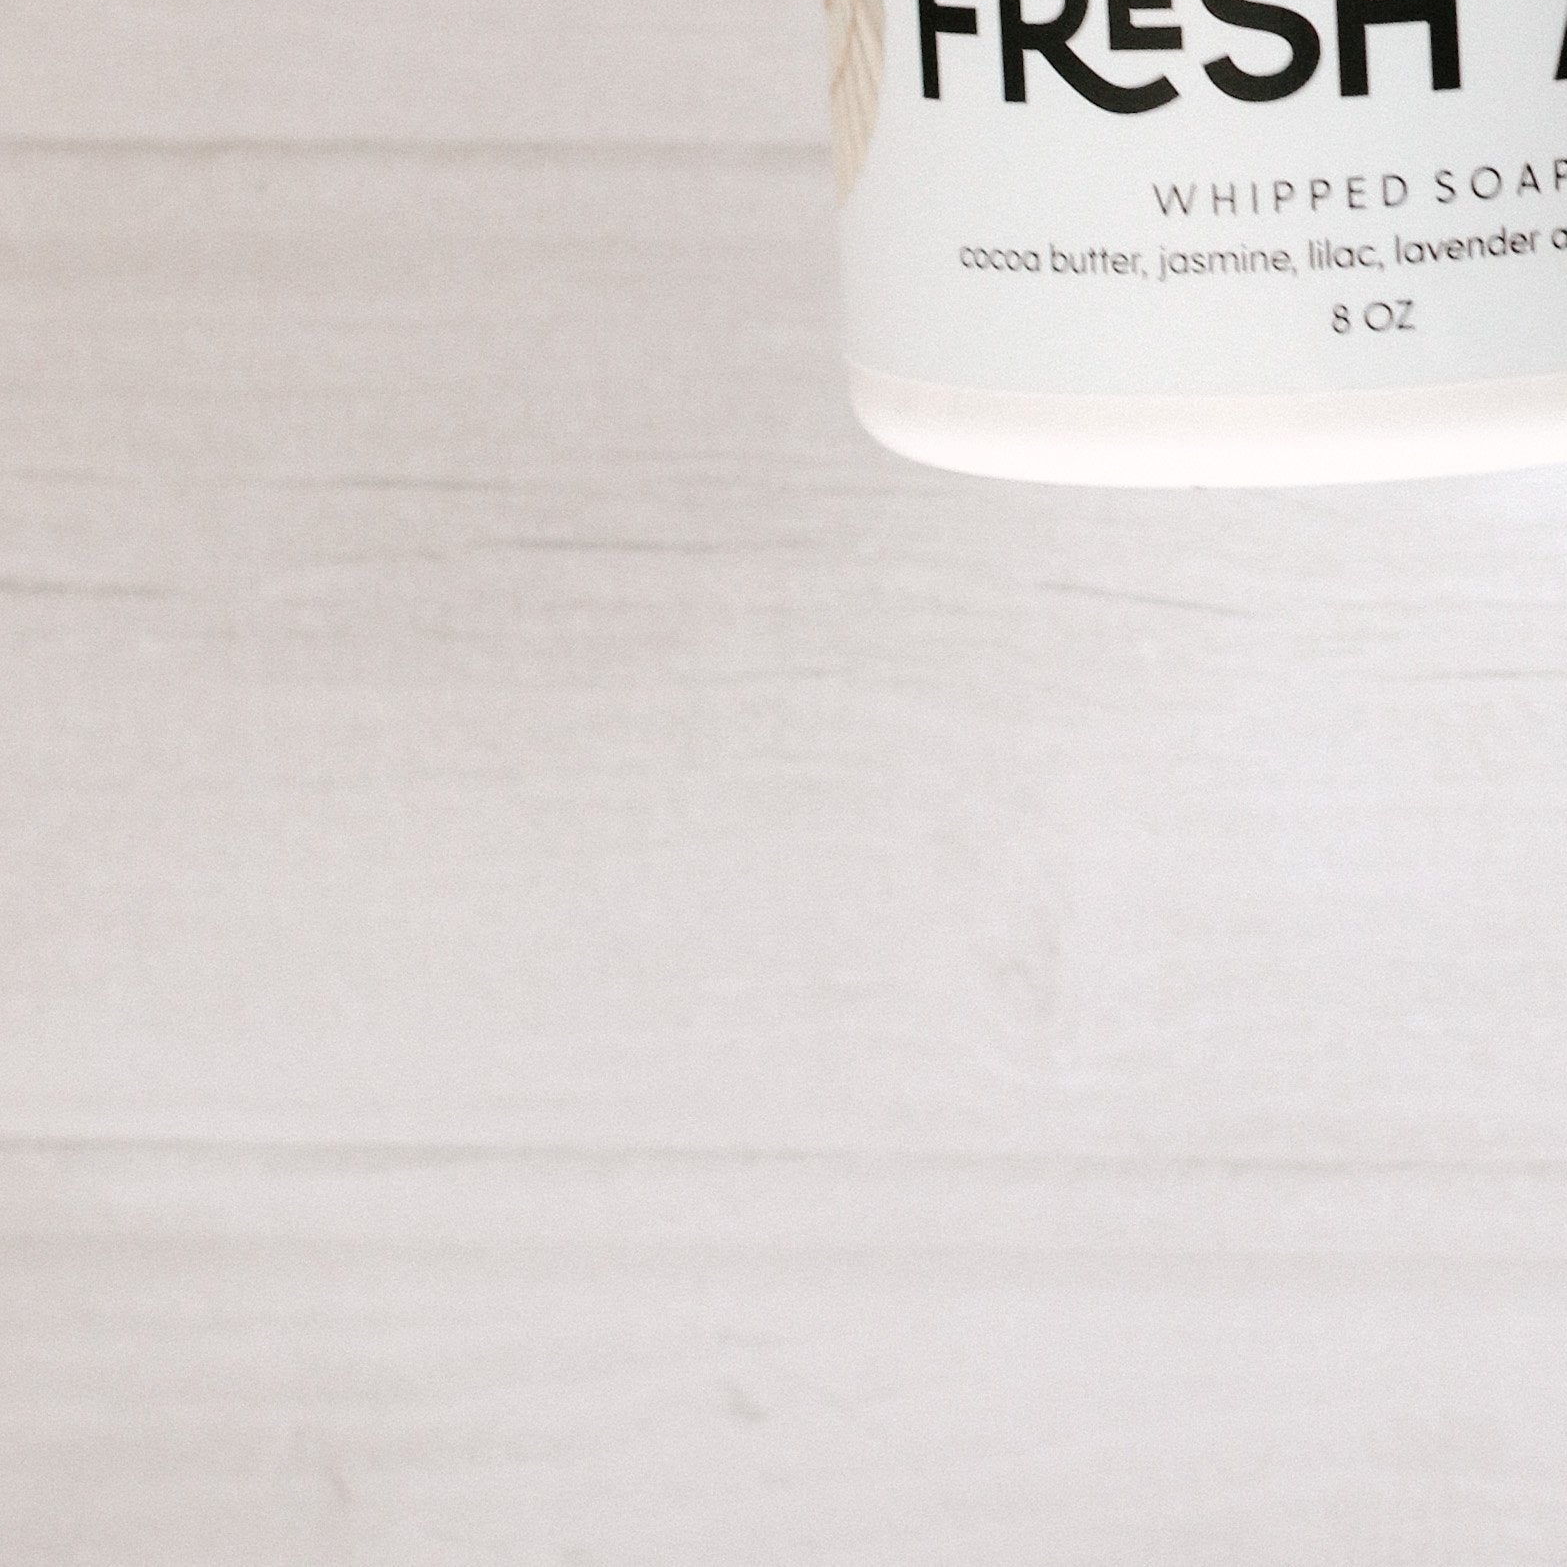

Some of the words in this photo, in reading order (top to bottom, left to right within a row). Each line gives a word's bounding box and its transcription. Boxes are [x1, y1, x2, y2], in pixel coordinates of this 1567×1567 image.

[1153, 172, 1410, 218] WHIPPED
[960, 244, 1040, 273] cocoa
[1049, 242, 1148, 280] butter,
[1157, 243, 1298, 282] jasmine,
[1308, 236, 1384, 271] lilac,
[1396, 227, 1540, 265] lavender
[1331, 303, 1351, 334] 8
[1363, 299, 1416, 331] OZ
